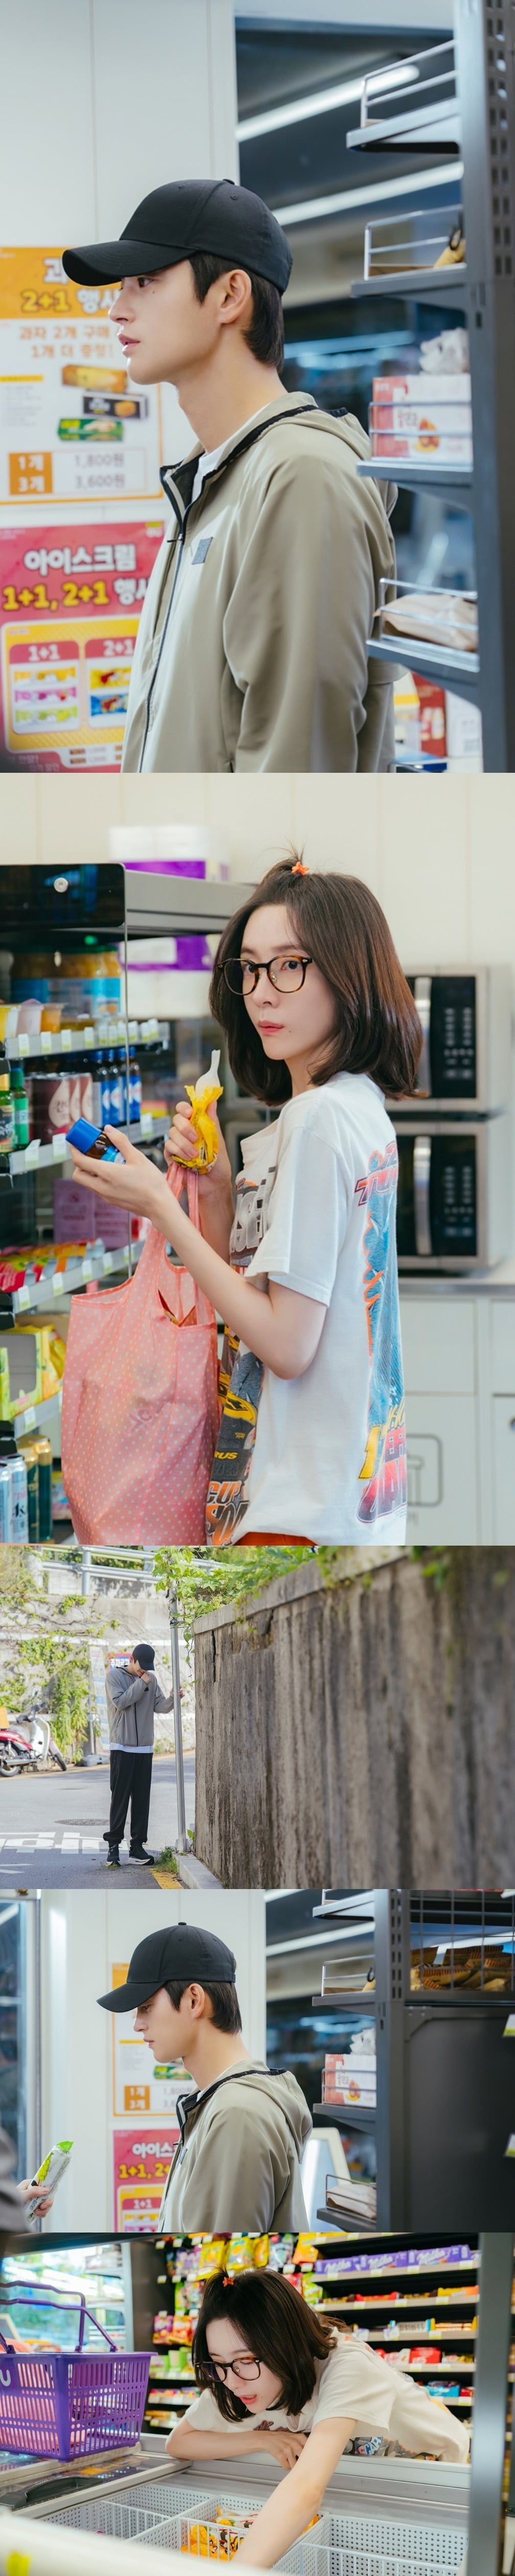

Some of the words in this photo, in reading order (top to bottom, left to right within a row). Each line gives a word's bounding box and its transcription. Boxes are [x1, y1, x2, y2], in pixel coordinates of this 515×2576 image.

[21, 289, 71, 313] 2+1
[20, 327, 46, 339] 과자
[54, 326, 76, 339] 2개
[83, 325, 109, 338] 구매
[32, 344, 54, 357] 1개
[61, 344, 73, 357] 더
[82, 343, 113, 357] 증정!
[18, 454, 44, 471] 1개
[76, 453, 124, 468] 1,800원
[18, 475, 44, 492] 3개
[76, 474, 124, 489] 3,600원
[24, 543, 136, 577] 아이스크림
[3, 583, 59, 611] 1+1,
[61, 580, 110, 607] 2+1
[29, 644, 60, 662] 1+1
[103, 639, 135, 657] 2+1
[130, 2086, 146, 2097] 1개
[130, 2100, 146, 2110] 3개
[132, 2142, 177, 2158] 아이스
[119, 2163, 152, 2179] 1+1,
[133, 2199, 152, 2209] 1+1
[367, 2255, 394, 2267] Milka
[416, 2249, 446, 2264] Milka
